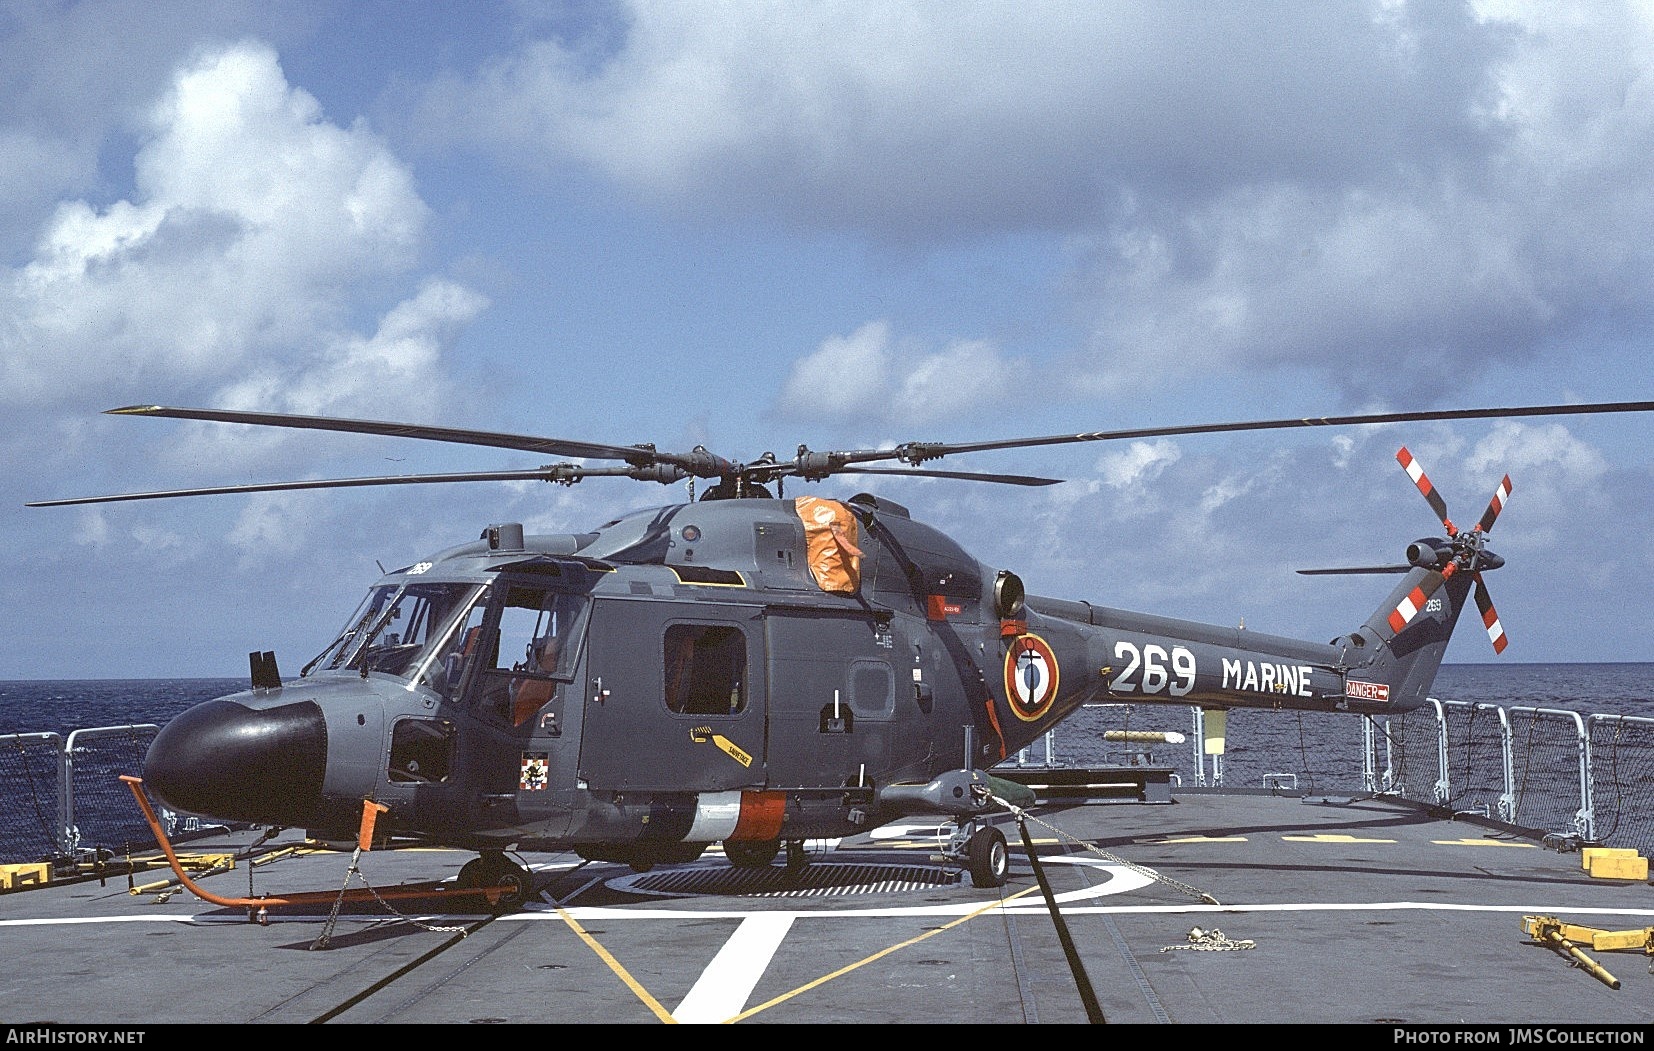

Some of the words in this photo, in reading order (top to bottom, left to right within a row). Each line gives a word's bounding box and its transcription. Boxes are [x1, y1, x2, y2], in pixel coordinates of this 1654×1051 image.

[406, 561, 433, 575] 269
[1425, 598, 1442, 612] 269
[1109, 641, 1197, 697] 269
[1221, 657, 1313, 697] MARINE
[1345, 682, 1378, 699] DANGER
